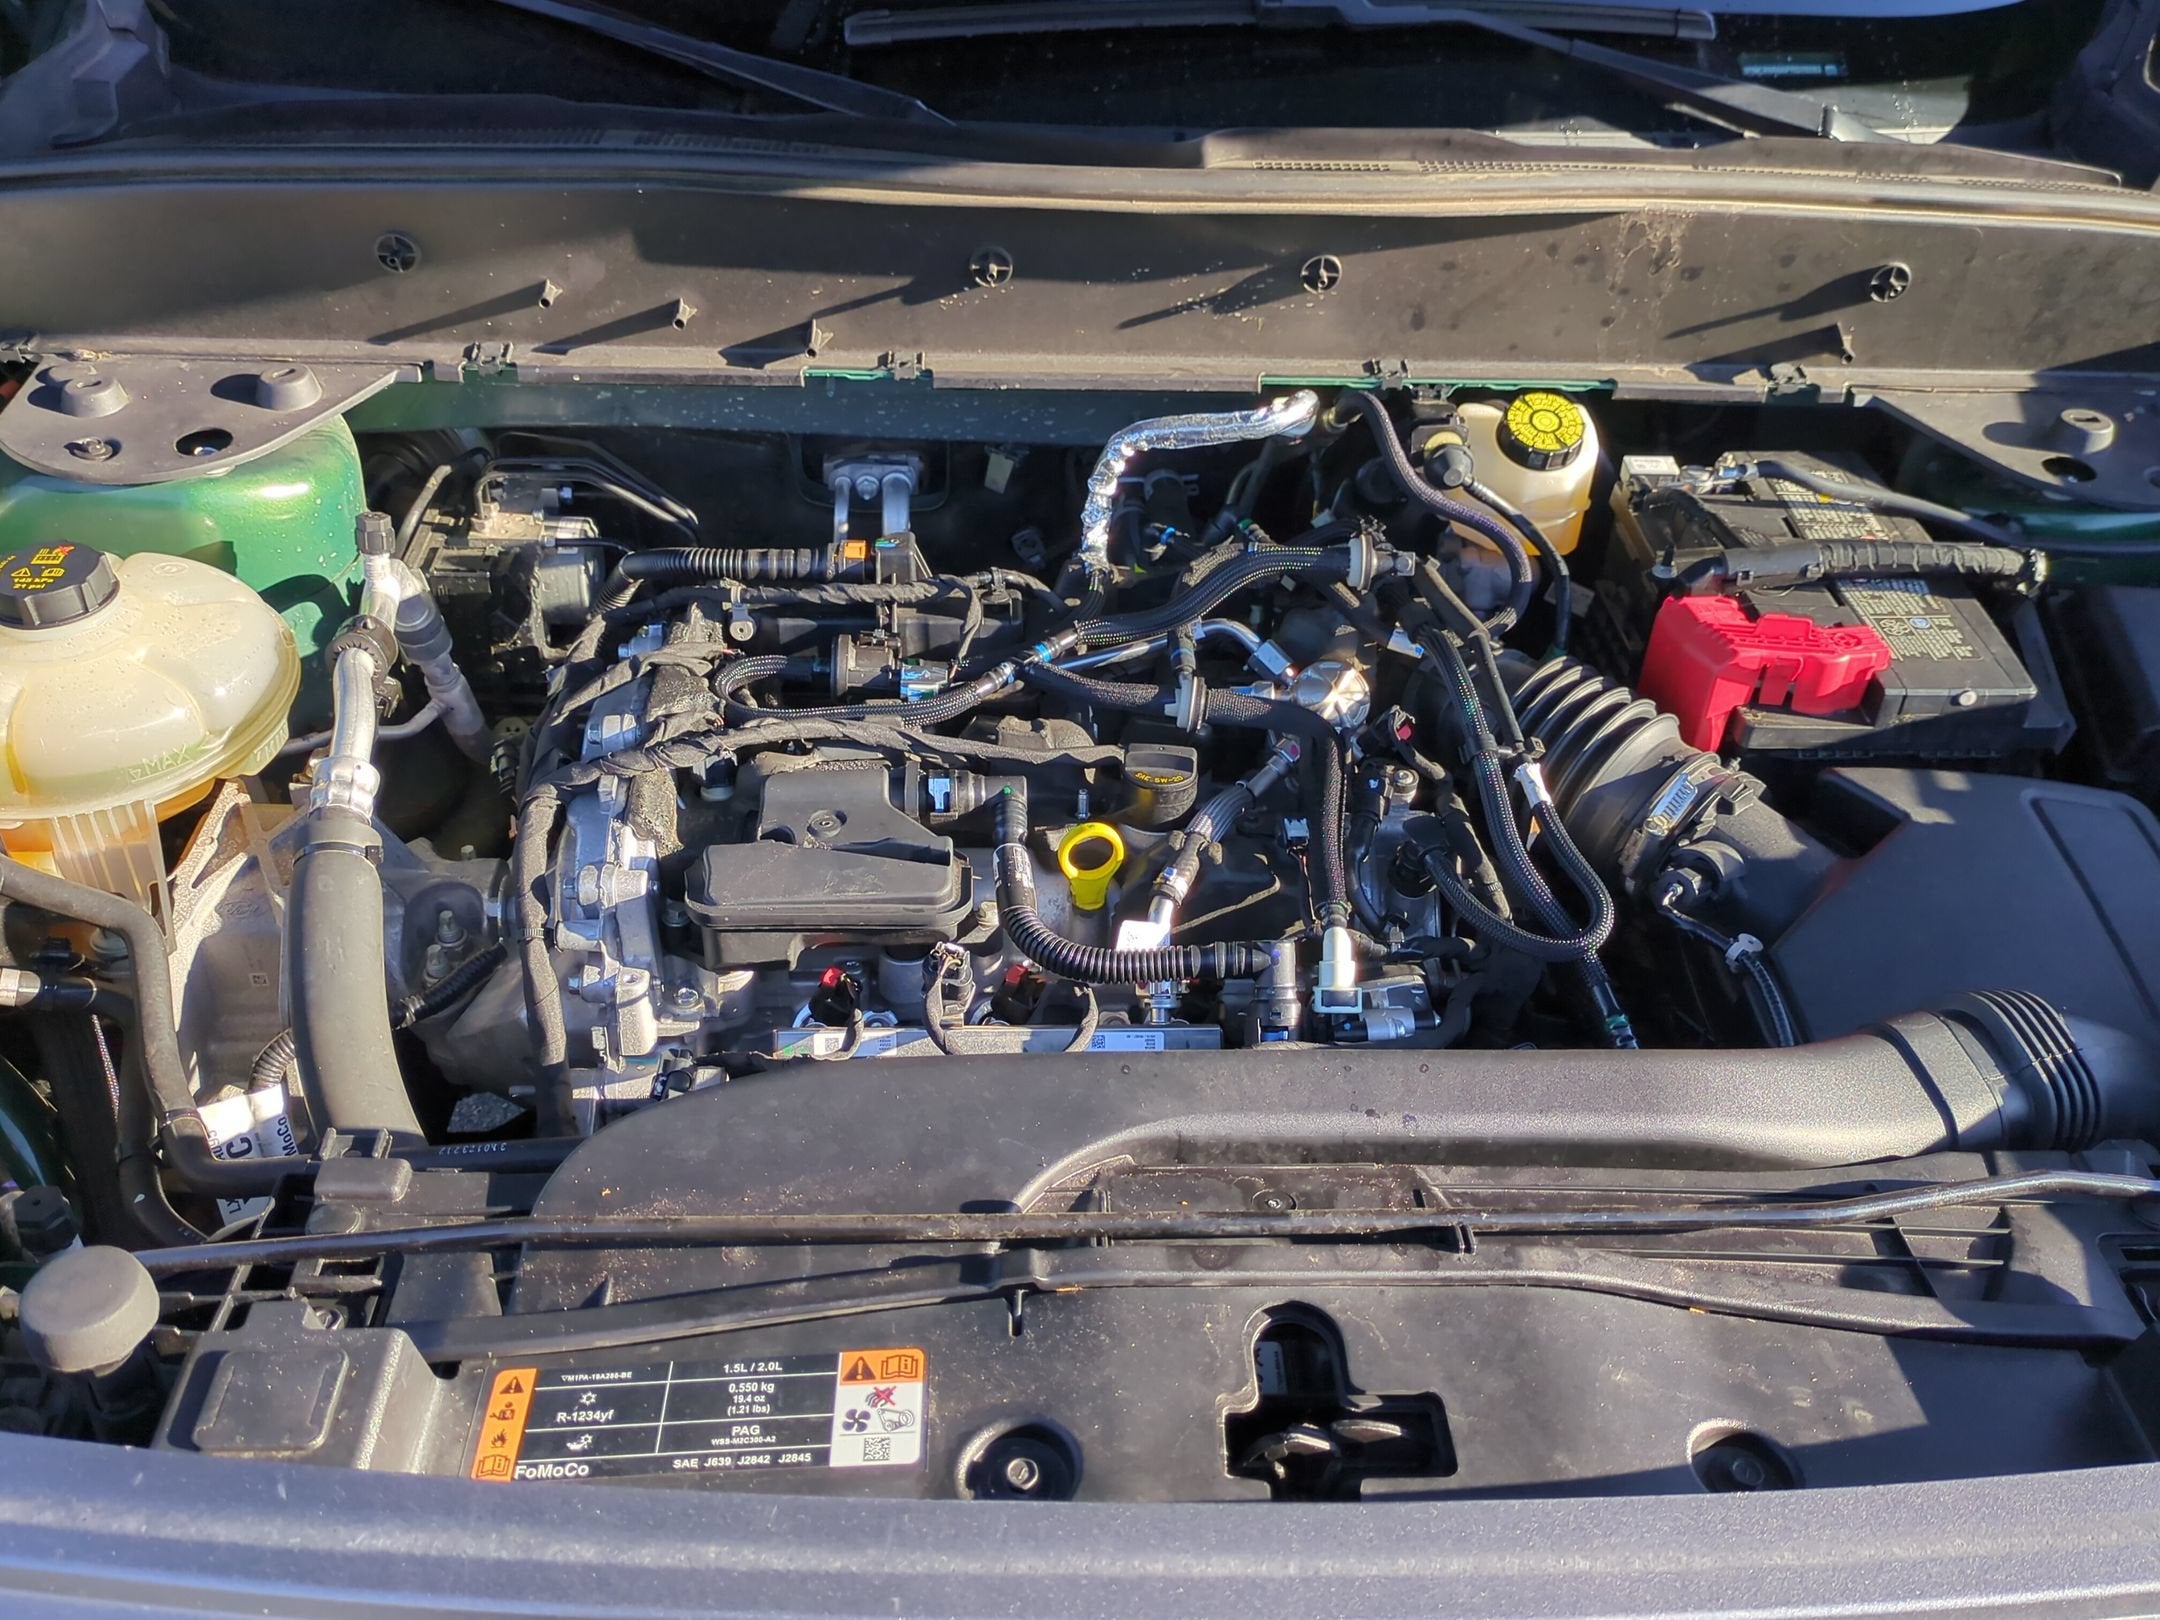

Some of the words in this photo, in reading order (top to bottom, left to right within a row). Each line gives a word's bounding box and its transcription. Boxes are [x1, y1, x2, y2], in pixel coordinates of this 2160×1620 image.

[141, 744, 192, 774] MAX
[723, 1362, 748, 1374] 1.5L
[757, 1361, 783, 1371] 2.0L
[728, 1382, 758, 1393] 0.550
[760, 1381, 775, 1393] kg
[733, 1394, 752, 1403] 19.4
[556, 1409, 615, 1423] R-1234yf
[727, 1405, 750, 1416] (1.21
[752, 1404, 771, 1414] lbs)
[731, 1425, 760, 1436] PAG
[672, 1458, 699, 1469] SAE
[703, 1457, 732, 1467] J639
[737, 1455, 771, 1465] J2842
[777, 1453, 812, 1463] J2845
[514, 1462, 590, 1480] FoMoCo
